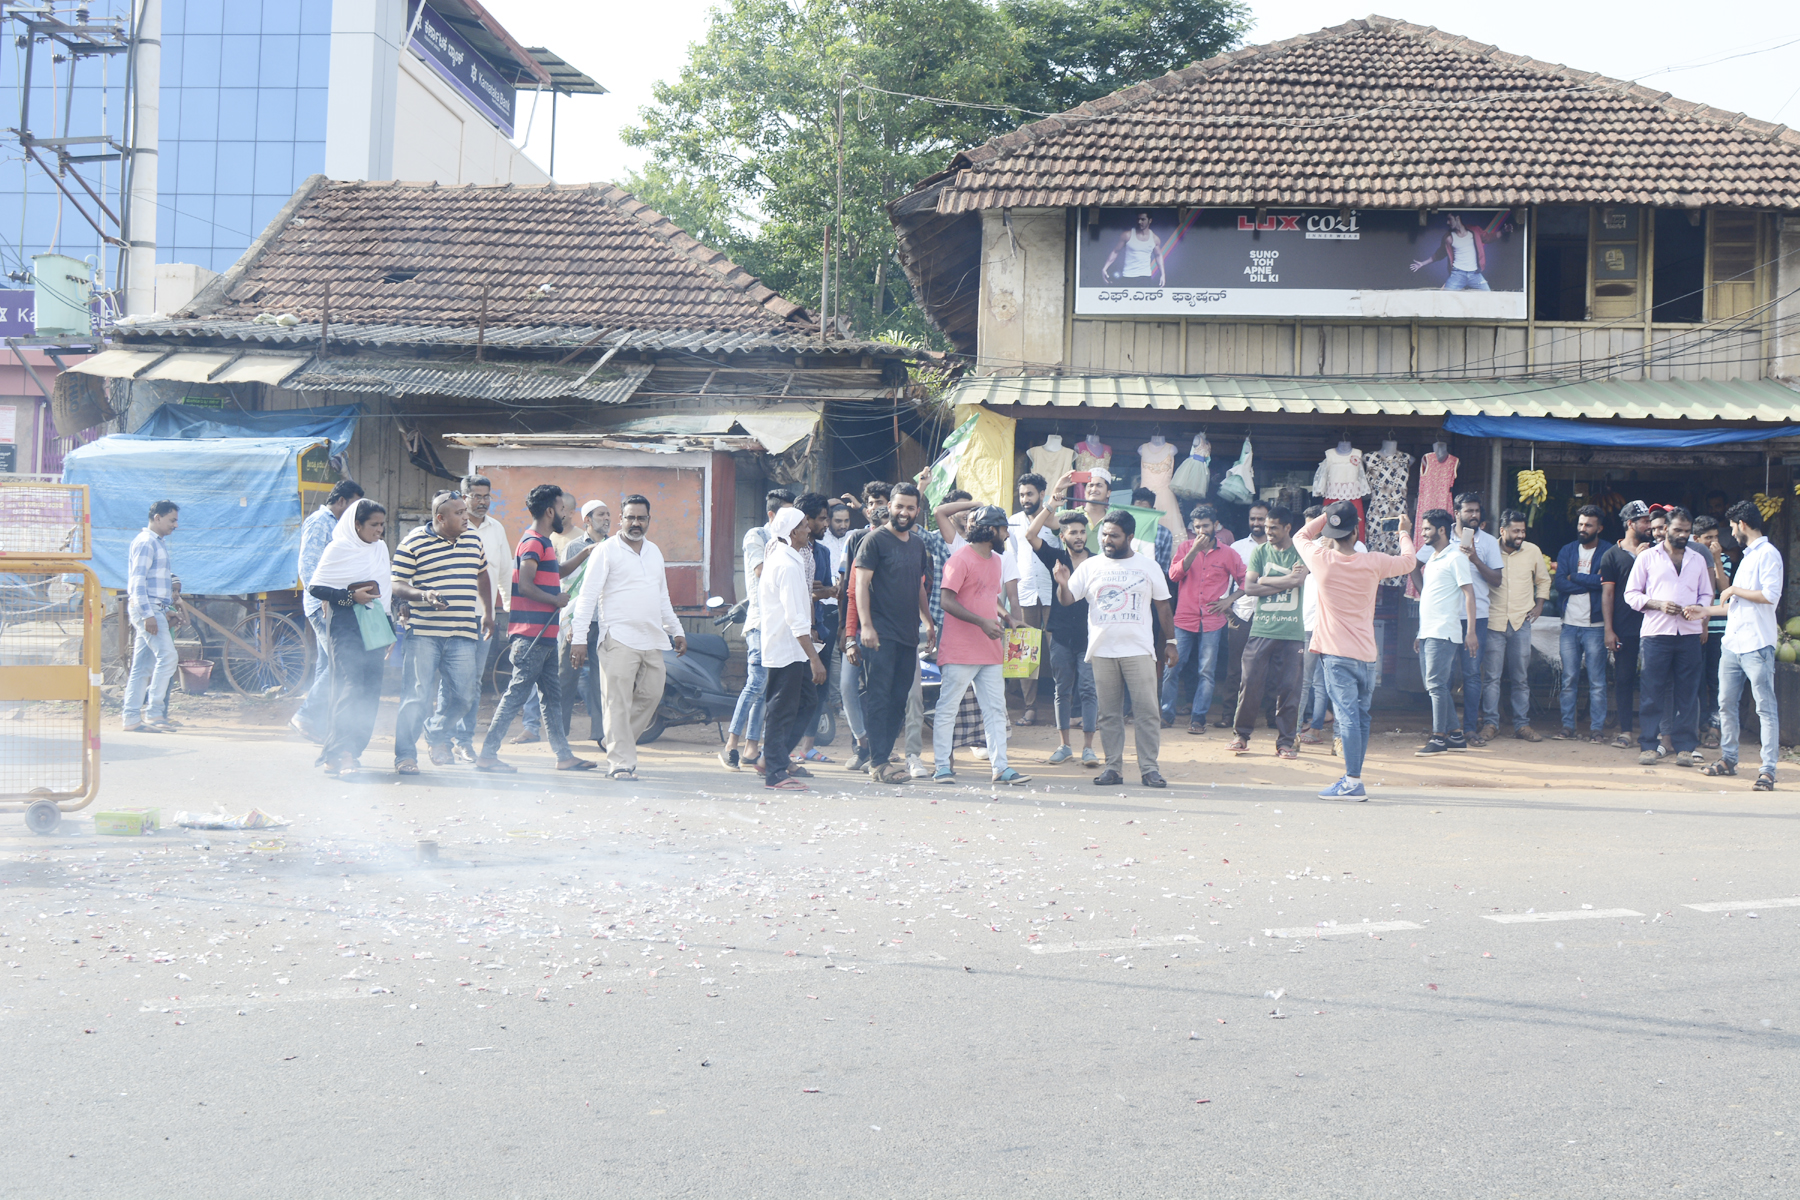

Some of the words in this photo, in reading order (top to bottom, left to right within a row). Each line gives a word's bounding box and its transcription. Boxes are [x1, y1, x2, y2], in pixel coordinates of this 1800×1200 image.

[479, 72, 500, 102] Karnataka
[500, 92, 511, 112] Bank
[1237, 215, 1301, 231] LUX
[1249, 250, 1280, 259] SUNO
[1252, 258, 1274, 266] TOH
[1243, 266, 1273, 275] APNE
[1249, 274, 1267, 282] DIL
[1268, 274, 1279, 282] KI
[1098, 289, 1164, 303] ಎಫ್.ಎಸ್
[1171, 289, 1228, 308] ಫ್ಯಾಷನ್
[1272, 614, 1298, 622] human
